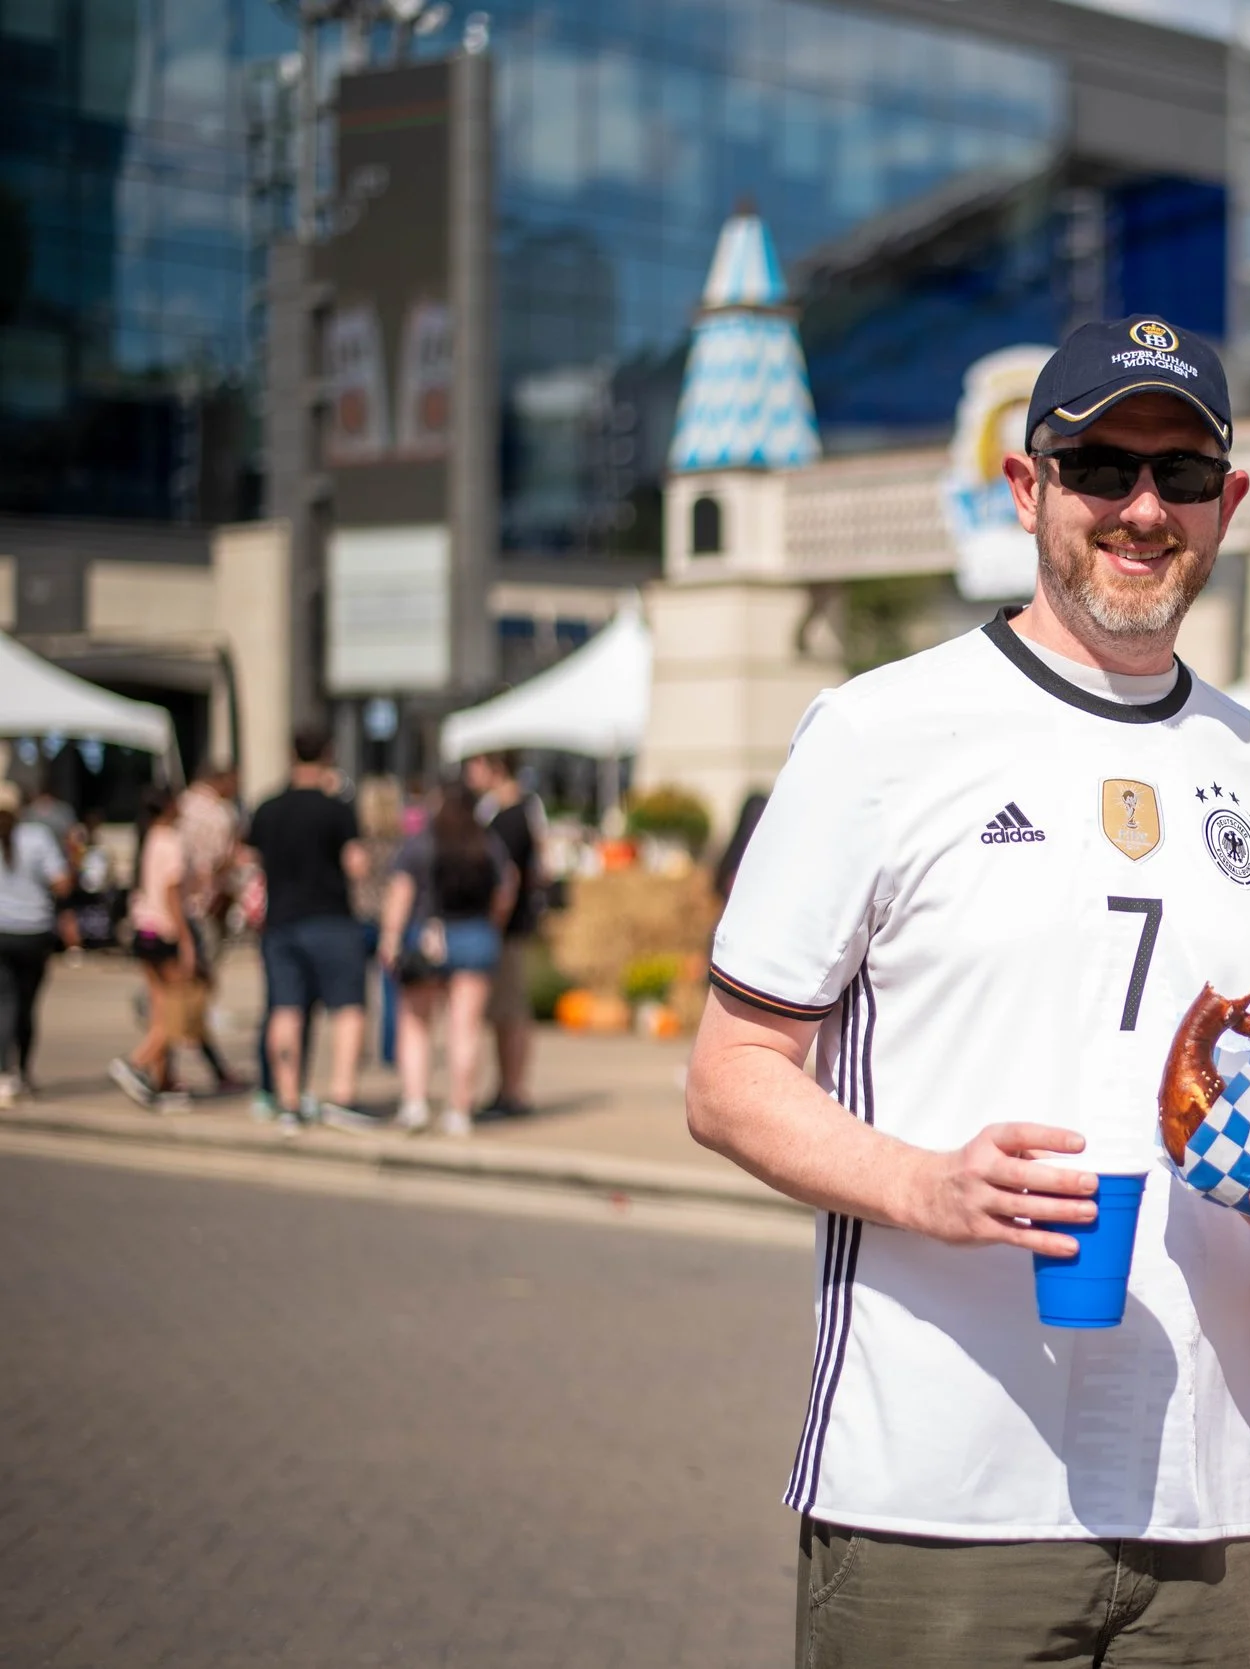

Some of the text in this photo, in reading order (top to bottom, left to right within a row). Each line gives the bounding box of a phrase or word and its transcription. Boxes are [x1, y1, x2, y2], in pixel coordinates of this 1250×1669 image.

[1144, 334, 1168, 348] HB
[1111, 350, 1198, 377] HOFBRÄUHAUS
[1123, 355, 1189, 379] MÜNCHEN
[980, 827, 1046, 844] adidas
[1107, 895, 1163, 1031] 7
